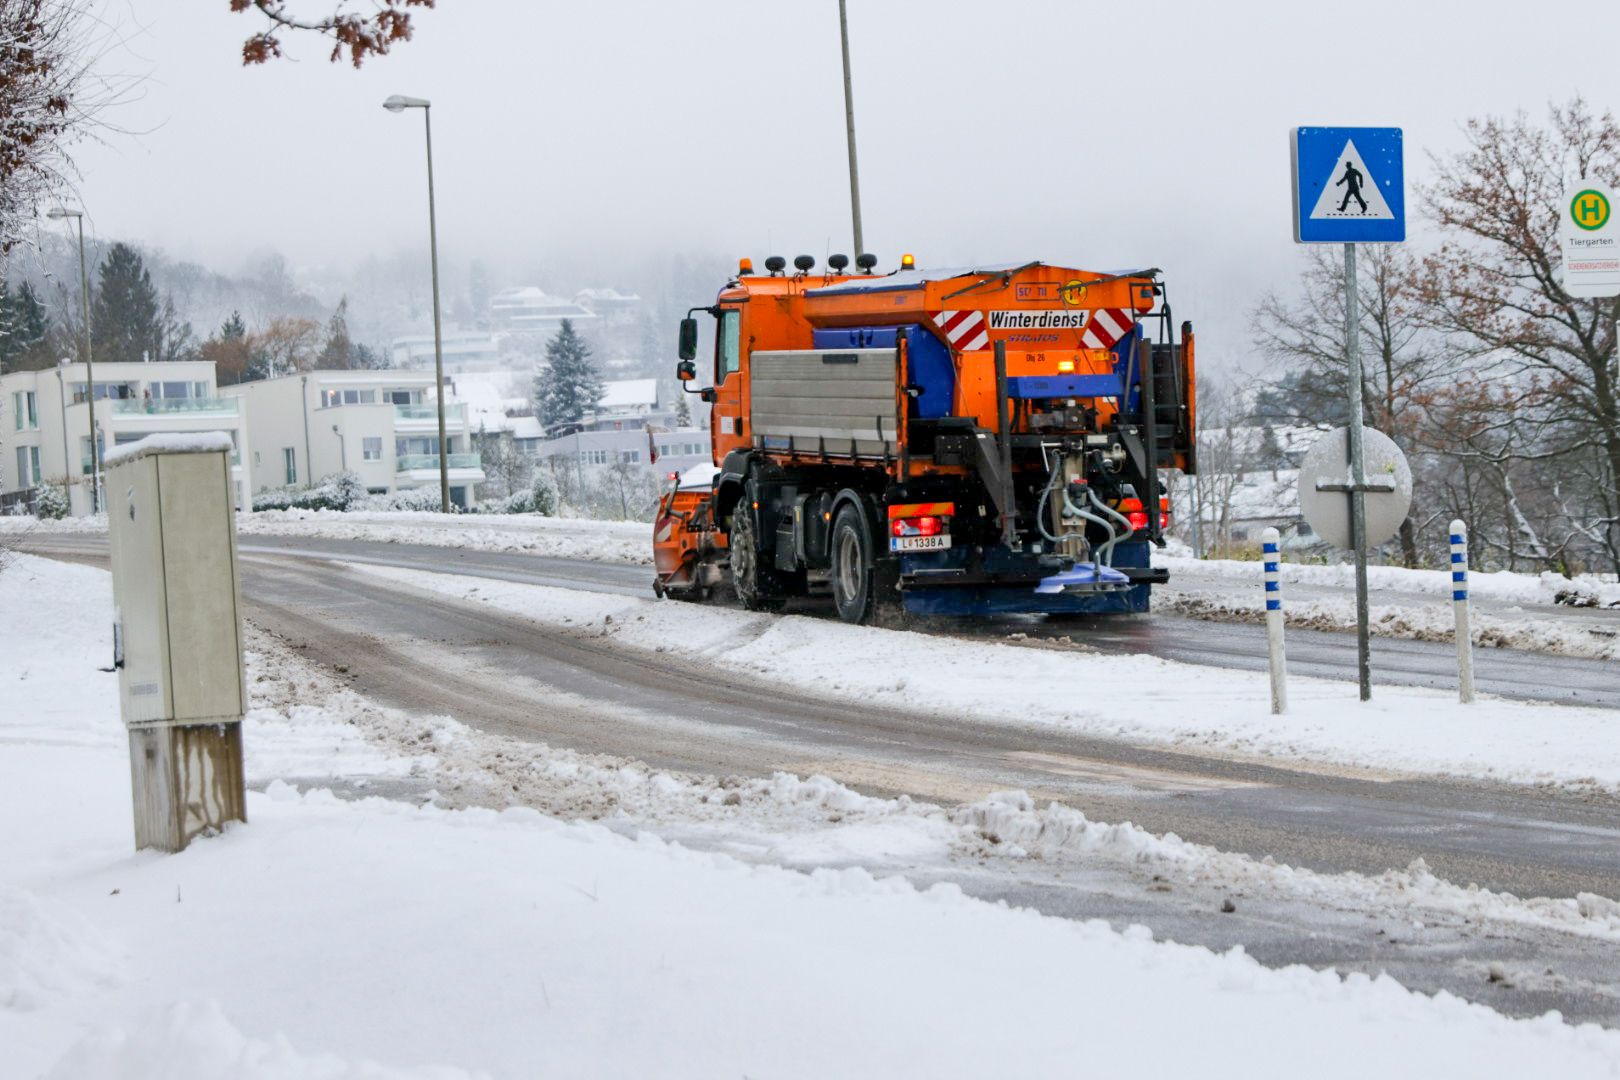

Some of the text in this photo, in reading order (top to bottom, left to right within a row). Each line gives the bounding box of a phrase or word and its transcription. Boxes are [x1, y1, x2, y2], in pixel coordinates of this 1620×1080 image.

[1581, 199, 1600, 221] H
[1569, 238, 1614, 247] Tiergarten
[991, 311, 1085, 328] Winterdienst
[1037, 353, 1046, 362] 26
